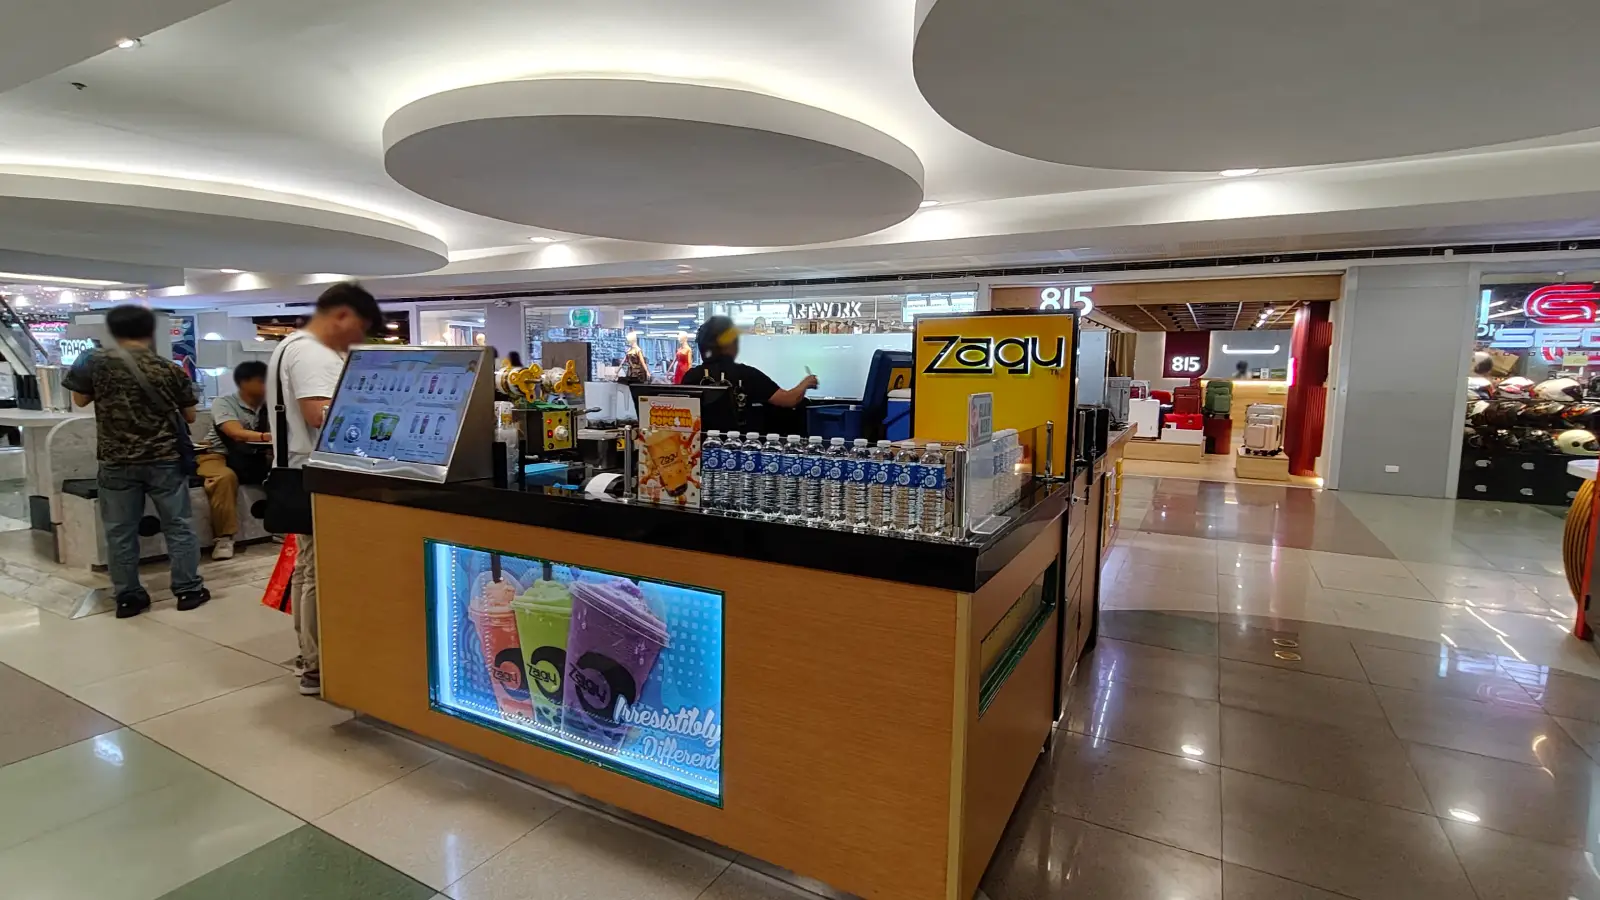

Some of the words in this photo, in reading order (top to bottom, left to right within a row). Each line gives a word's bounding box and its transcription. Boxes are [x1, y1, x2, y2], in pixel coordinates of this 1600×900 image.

[788, 301, 862, 319] ARTWORK
[1040, 286, 1093, 317] 815
[922, 335, 1066, 375] Zagu
[1171, 356, 1201, 372] 815
[613, 694, 721, 748] Irresistibly
[642, 735, 720, 771] Different
